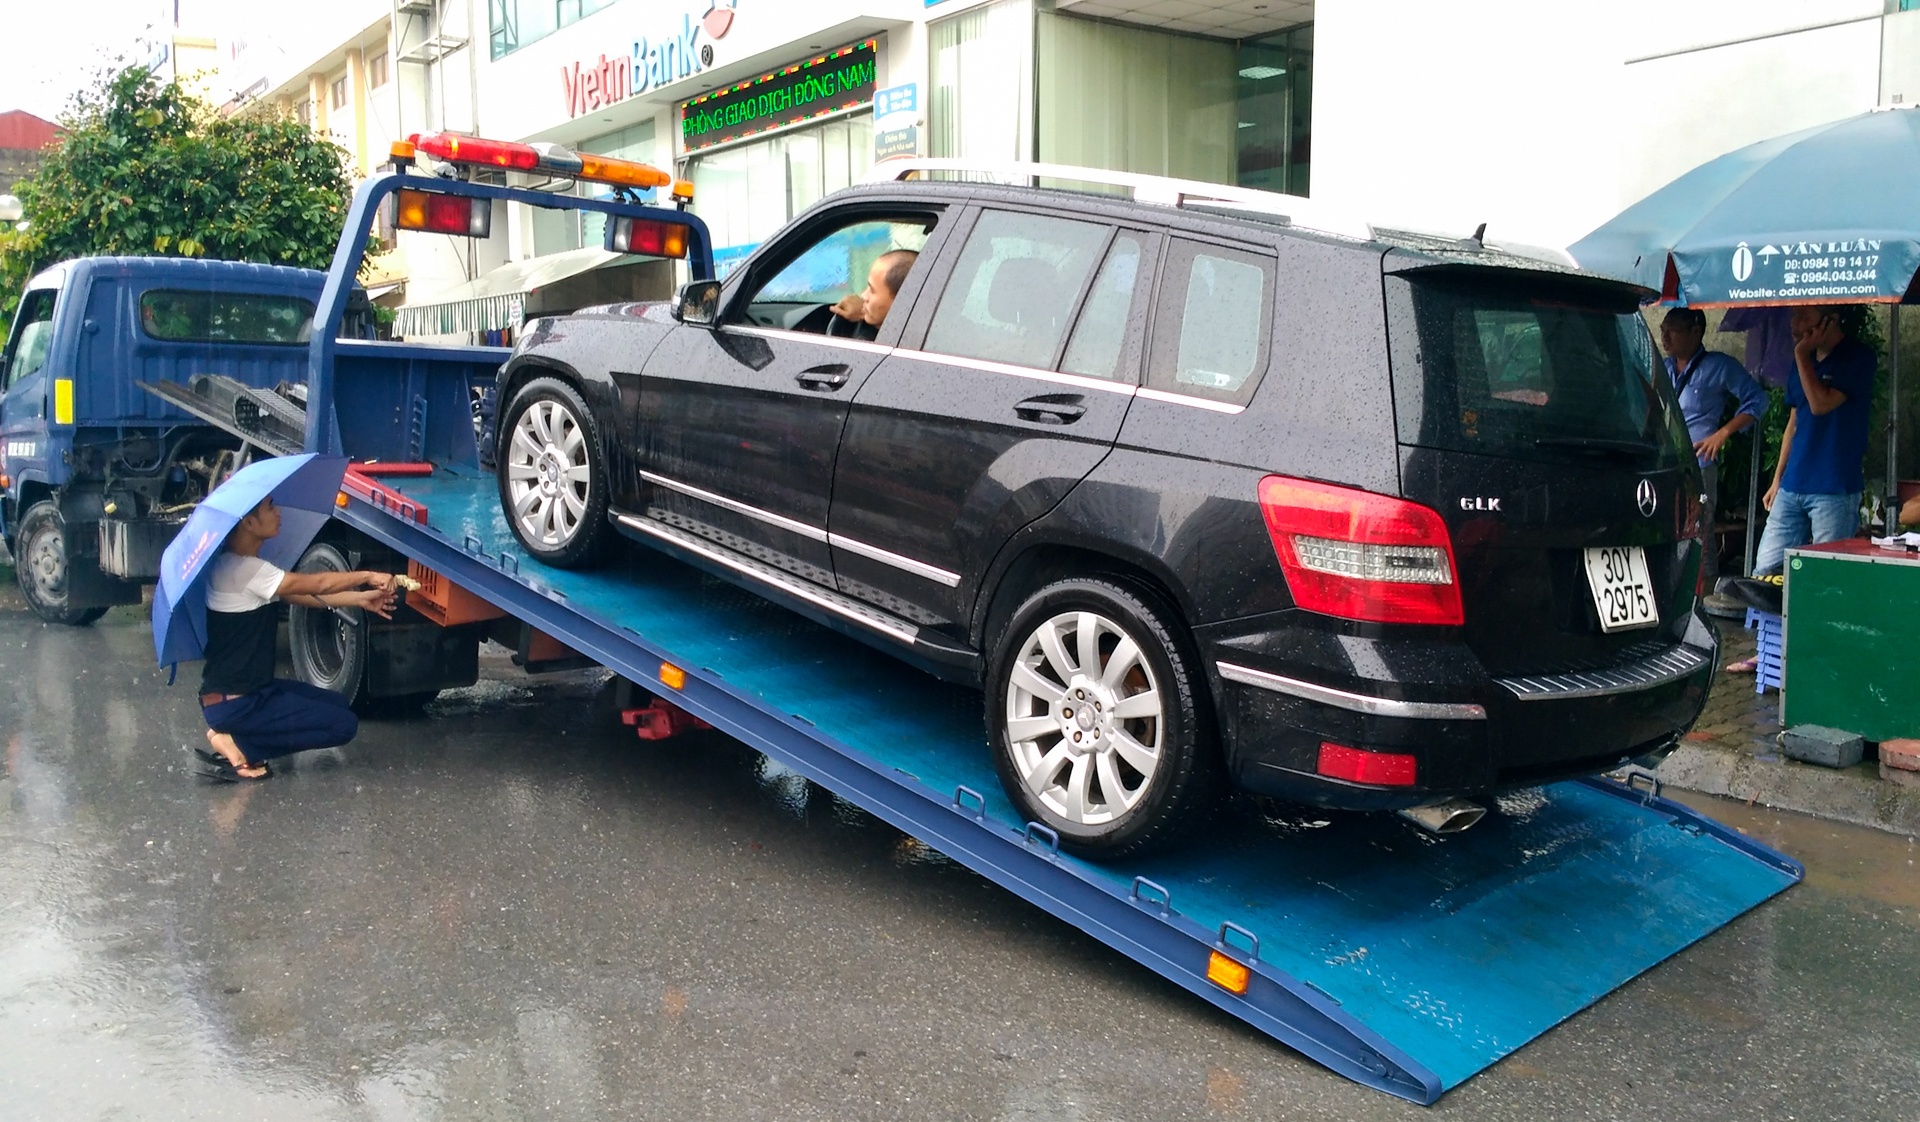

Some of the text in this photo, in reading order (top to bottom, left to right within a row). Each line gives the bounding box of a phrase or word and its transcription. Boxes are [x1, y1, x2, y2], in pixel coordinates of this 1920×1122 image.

[561, 13, 702, 118] VietinBank
[682, 60, 873, 138] PHÒNG GIAO DỊCH ĐÔNG NAM
[1781, 237, 1881, 255] VĂN LUÂN
[1802, 257, 1829, 269] 0984
[1832, 257, 1846, 268] 19
[1850, 256, 1862, 267] 14
[1865, 255, 1879, 266] 17
[1728, 284, 1876, 299] Website: oduvanluan.com
[1460, 497, 1501, 511] GLK
[1601, 547, 1633, 584] 30Y
[1604, 584, 1649, 623] 2975
